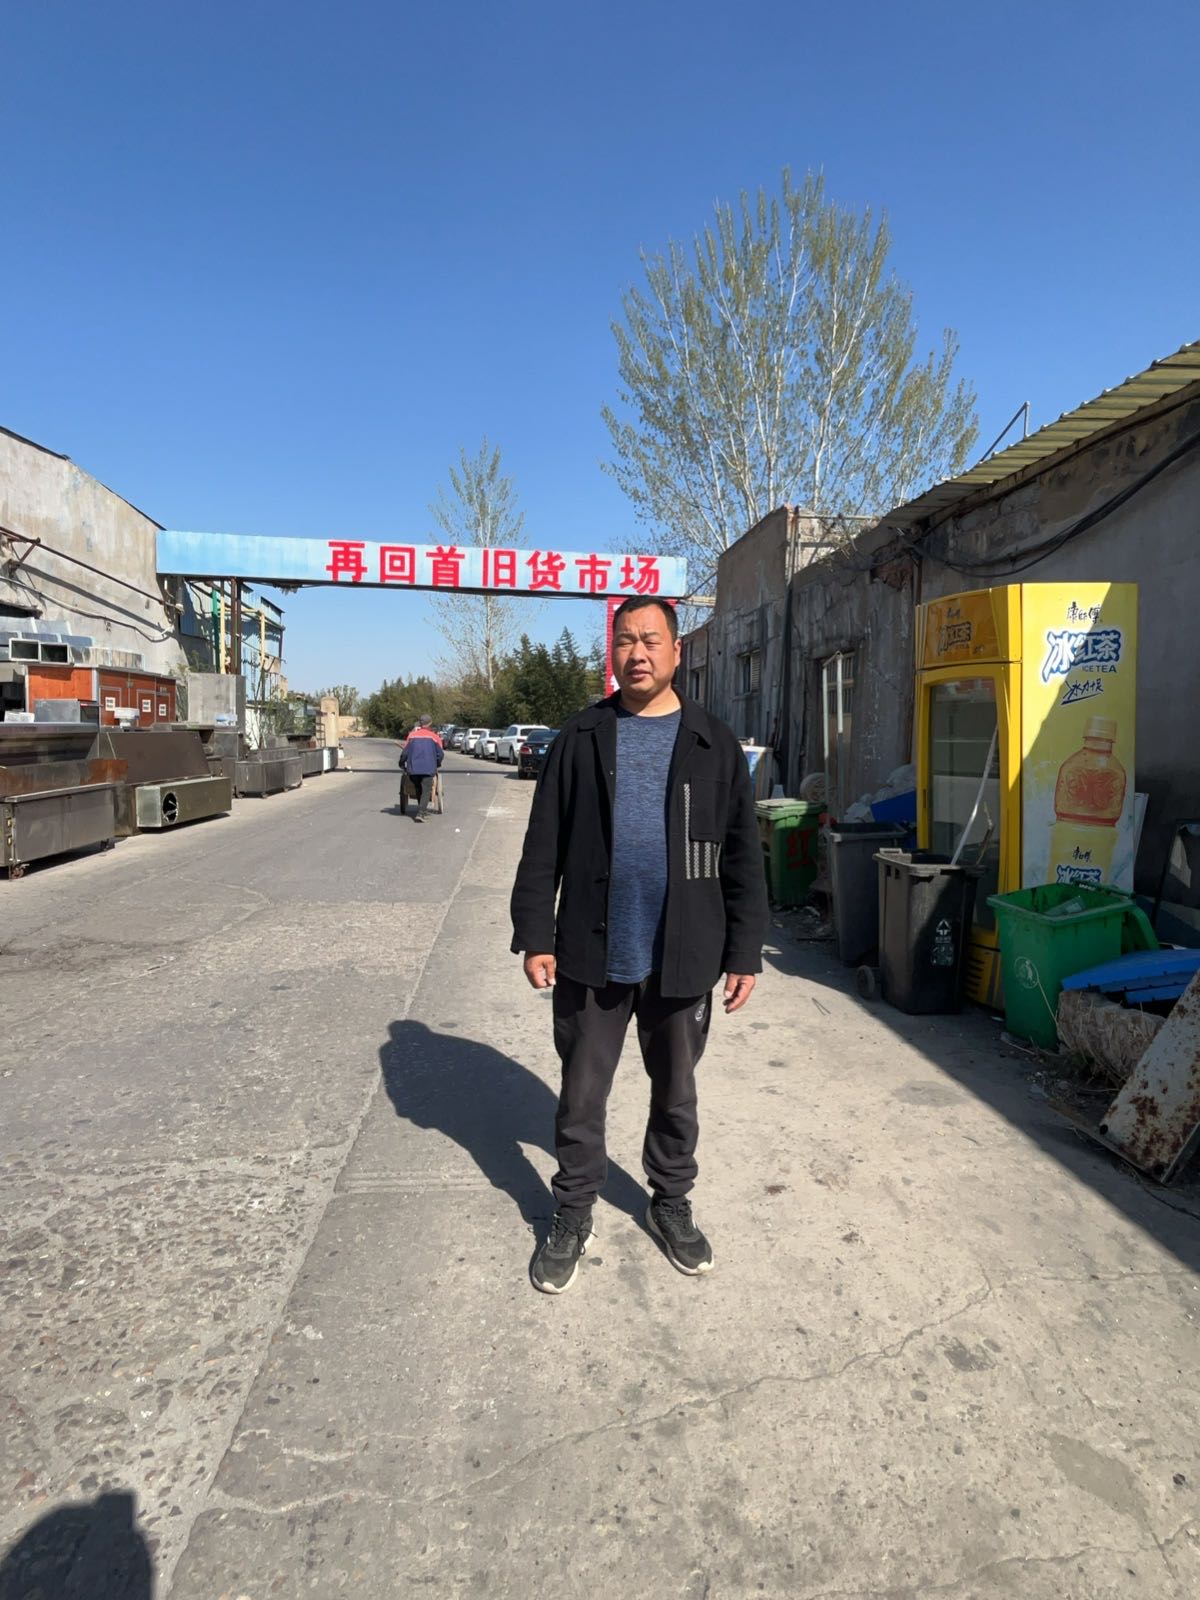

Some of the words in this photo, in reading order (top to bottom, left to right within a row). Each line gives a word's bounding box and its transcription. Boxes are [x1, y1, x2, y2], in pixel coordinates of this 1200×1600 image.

[326, 540, 660, 595] 再回首旧货市场
[1042, 629, 1121, 683] 冰红茶
[1096, 664, 1117, 673] TEA
